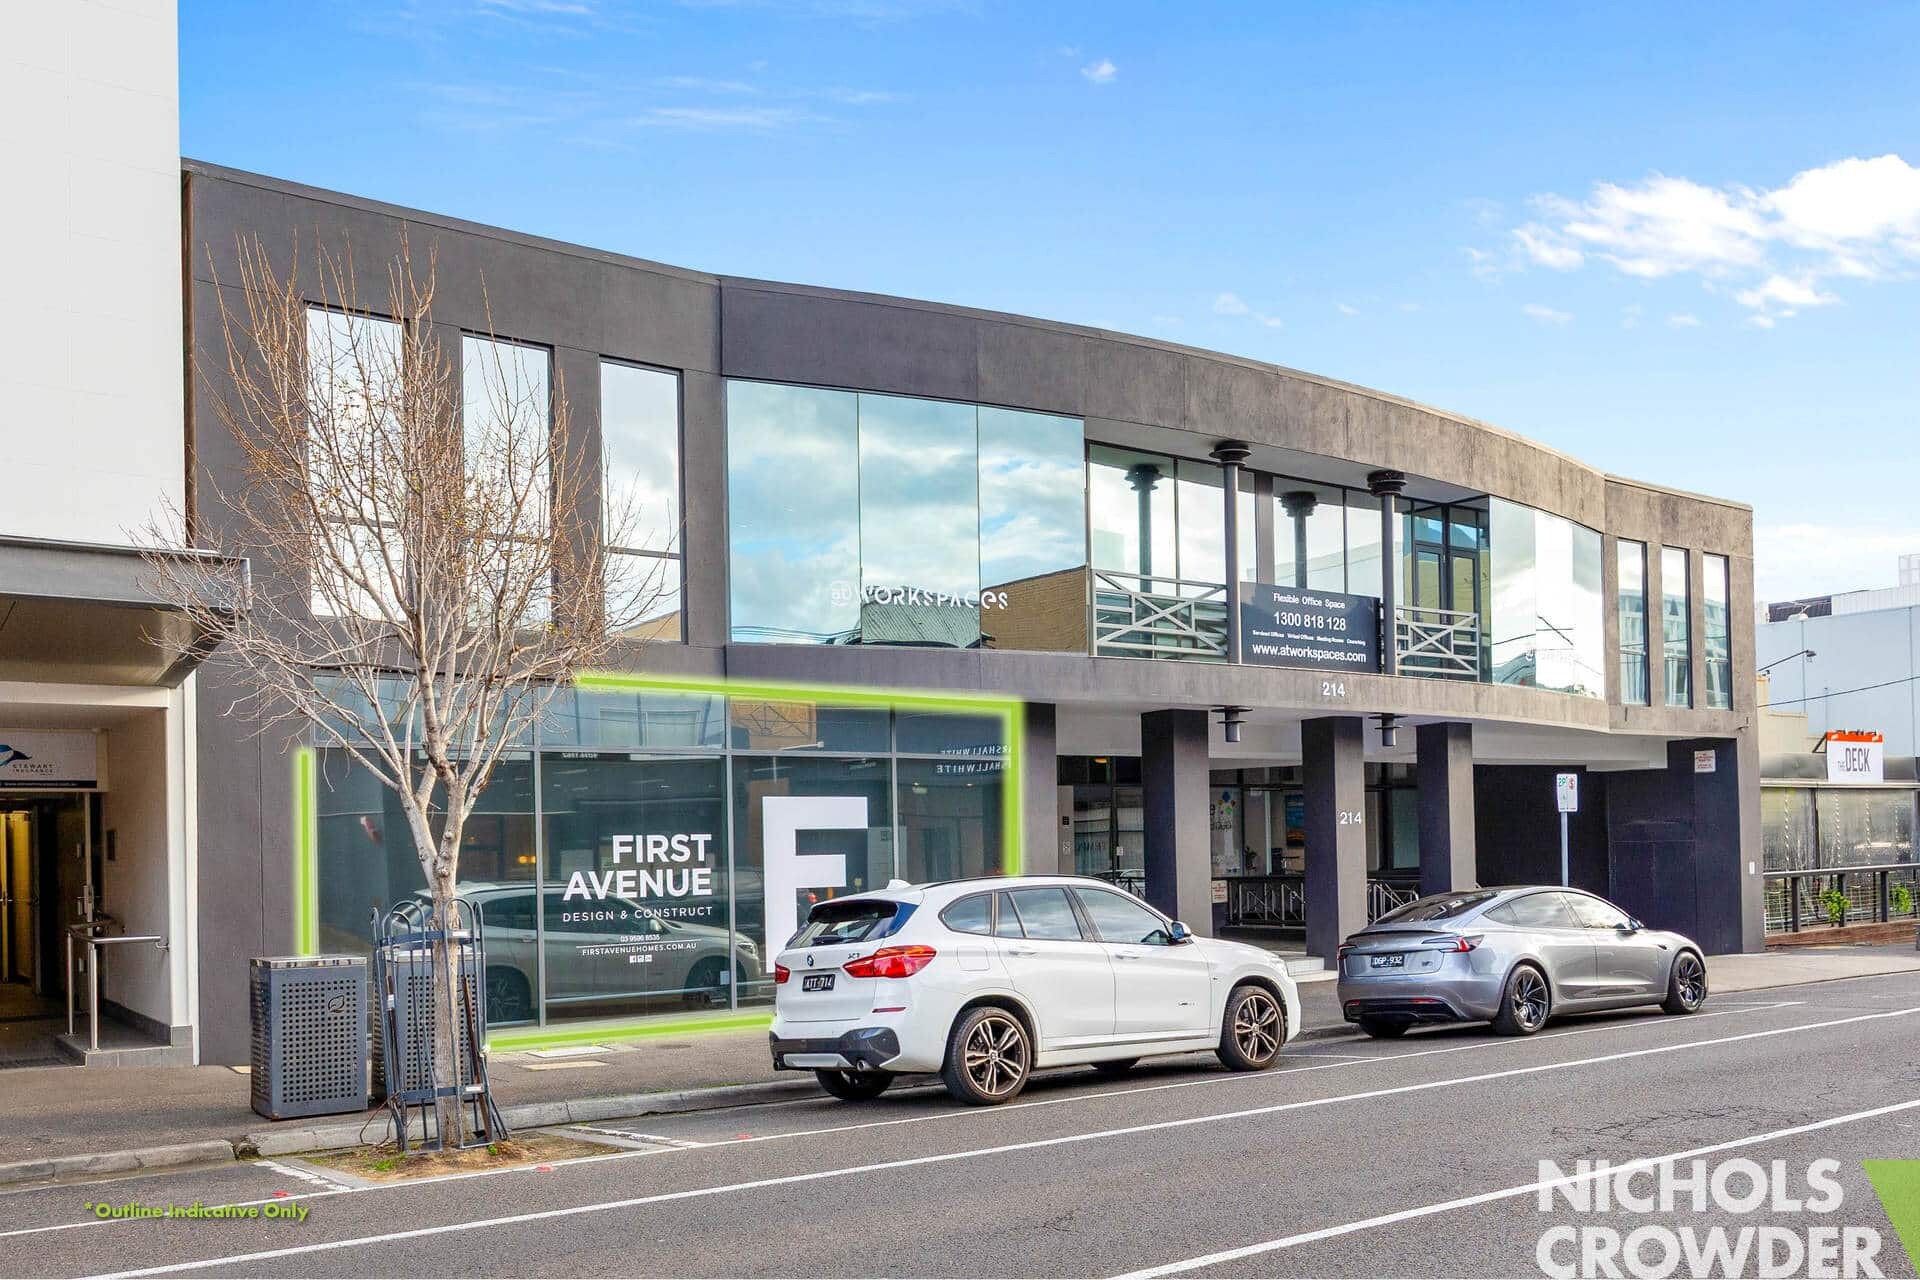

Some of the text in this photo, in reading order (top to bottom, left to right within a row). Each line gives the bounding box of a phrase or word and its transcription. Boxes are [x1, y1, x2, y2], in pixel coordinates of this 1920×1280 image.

[1273, 592, 1346, 609] Flexible Office Space
[1273, 611, 1346, 631] 1300 818 128
[1252, 644, 1367, 663] www.atworkspaces.com
[1322, 682, 1346, 697] 214
[1845, 747, 1871, 772] DECK
[1339, 811, 1362, 825] 214
[612, 833, 712, 864] FIRST
[562, 867, 713, 901] AVENUE
[762, 796, 868, 973] F
[562, 906, 713, 922] DESIGN & CONSTRUCT
[582, 942, 697, 956] FIRSTAVENUEHOMES.COM.AU
